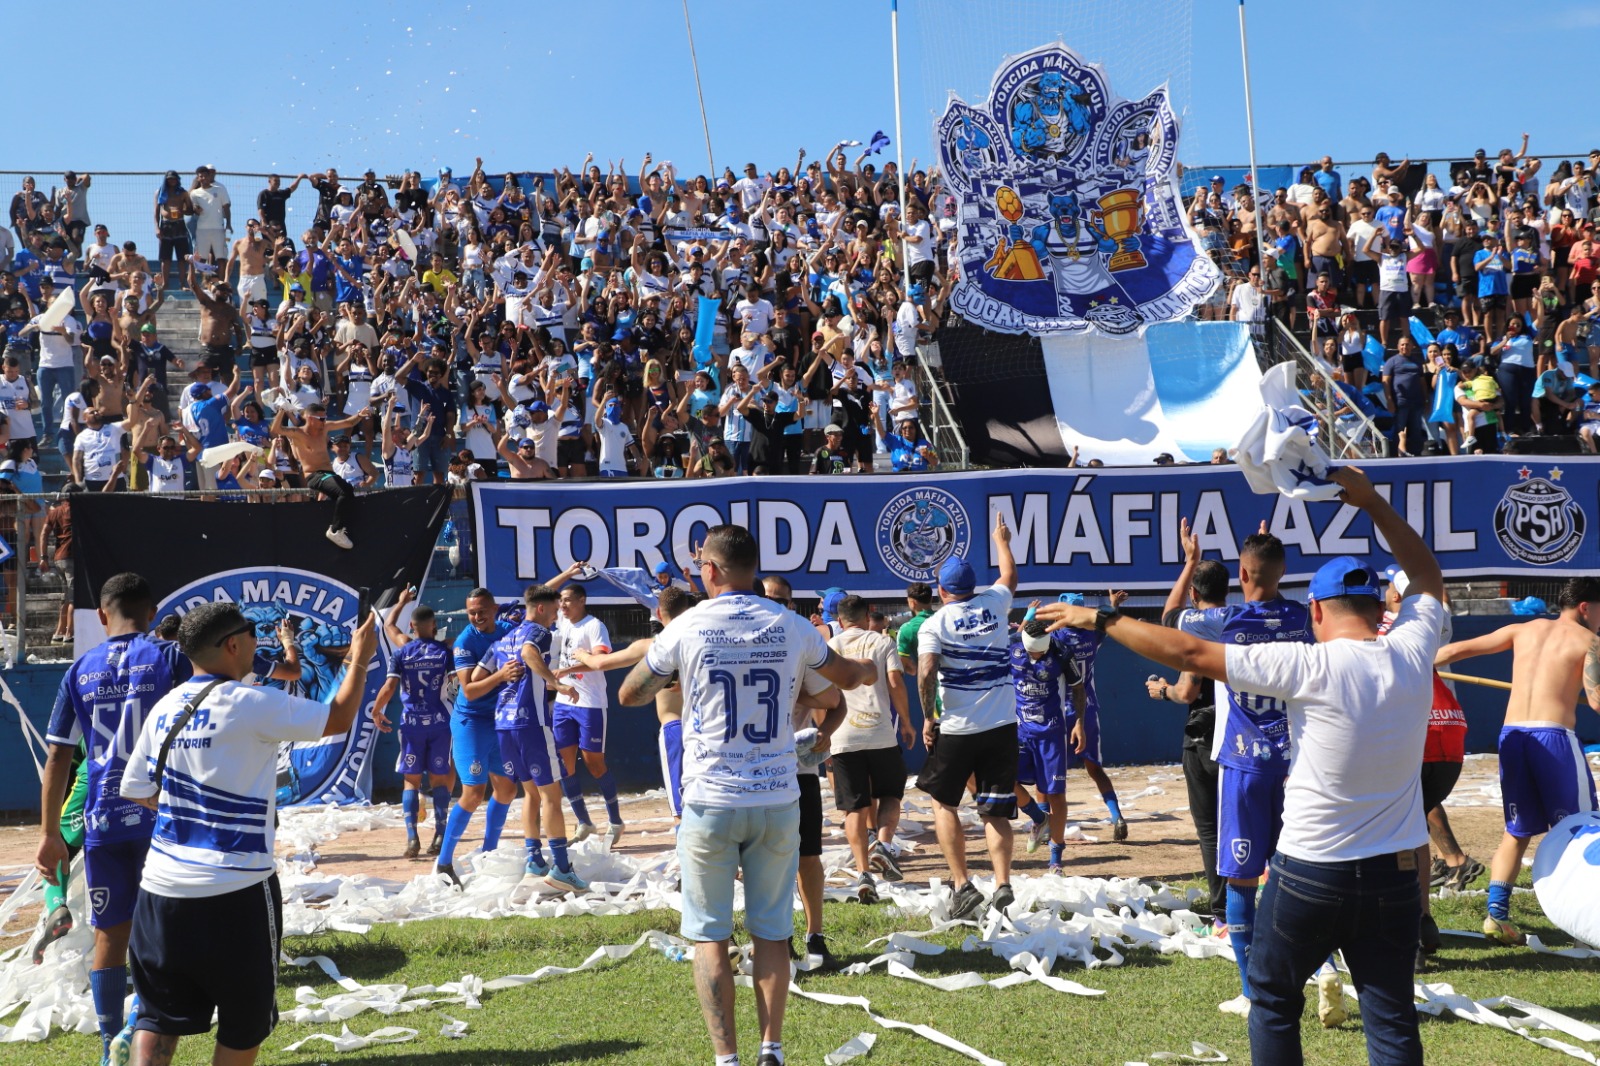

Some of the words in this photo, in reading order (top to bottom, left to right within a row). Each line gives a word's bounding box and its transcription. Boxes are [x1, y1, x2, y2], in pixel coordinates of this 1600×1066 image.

[995, 61, 1039, 110] TORCIDA
[1043, 54, 1081, 80] MÁFIA
[1081, 77, 1103, 113] AZUL
[985, 123, 1001, 151] AZUL
[1098, 107, 1131, 160] TORCIDA
[881, 495, 913, 532] TORCIDA
[915, 490, 947, 505] MÁFIA
[947, 503, 965, 528] AZUL
[987, 475, 1240, 567] MÁFIA
[1268, 480, 1477, 556] AZUL
[1515, 501, 1563, 543] PSA
[882, 545, 930, 580] QUEBRADA
[242, 579, 345, 625] MAFIA
[699, 629, 726, 637] NOVA
[705, 636, 746, 645] ALIANÇA
[97, 682, 134, 696] BANCA
[708, 668, 781, 743] 13
[1236, 842, 1248, 859] S
[92, 890, 105, 908] S
